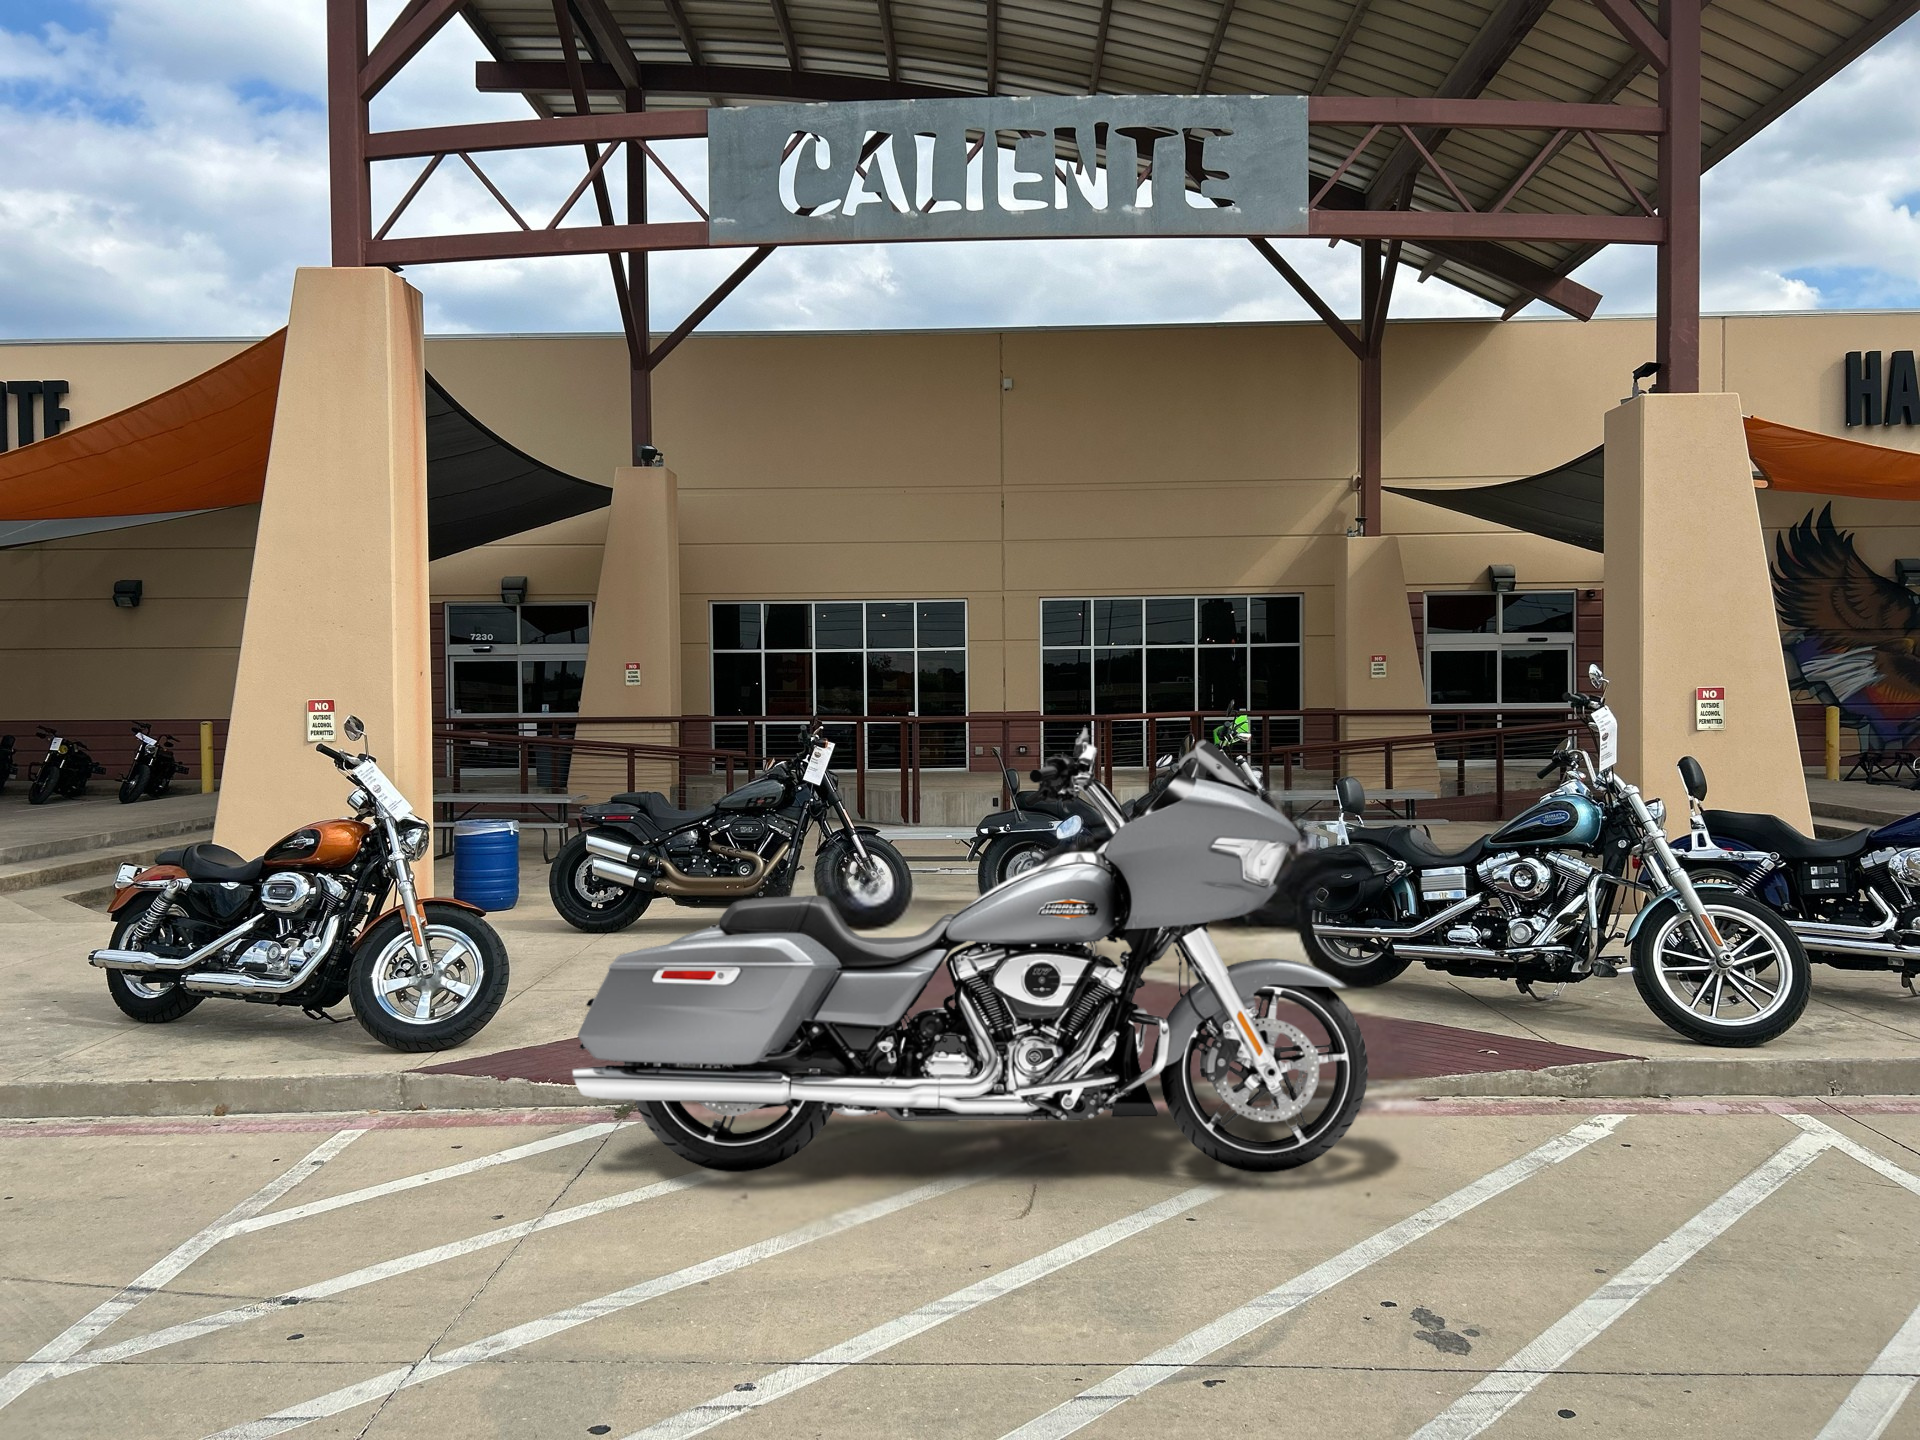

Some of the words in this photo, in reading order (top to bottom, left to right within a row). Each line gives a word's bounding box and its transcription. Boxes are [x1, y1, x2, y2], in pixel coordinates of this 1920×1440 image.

[778, 122, 1236, 217] CALIENTE
[0, 381, 70, 453] TE
[470, 633, 494, 641] 7230
[1702, 690, 1718, 699] NO
[314, 702, 329, 711] NO
